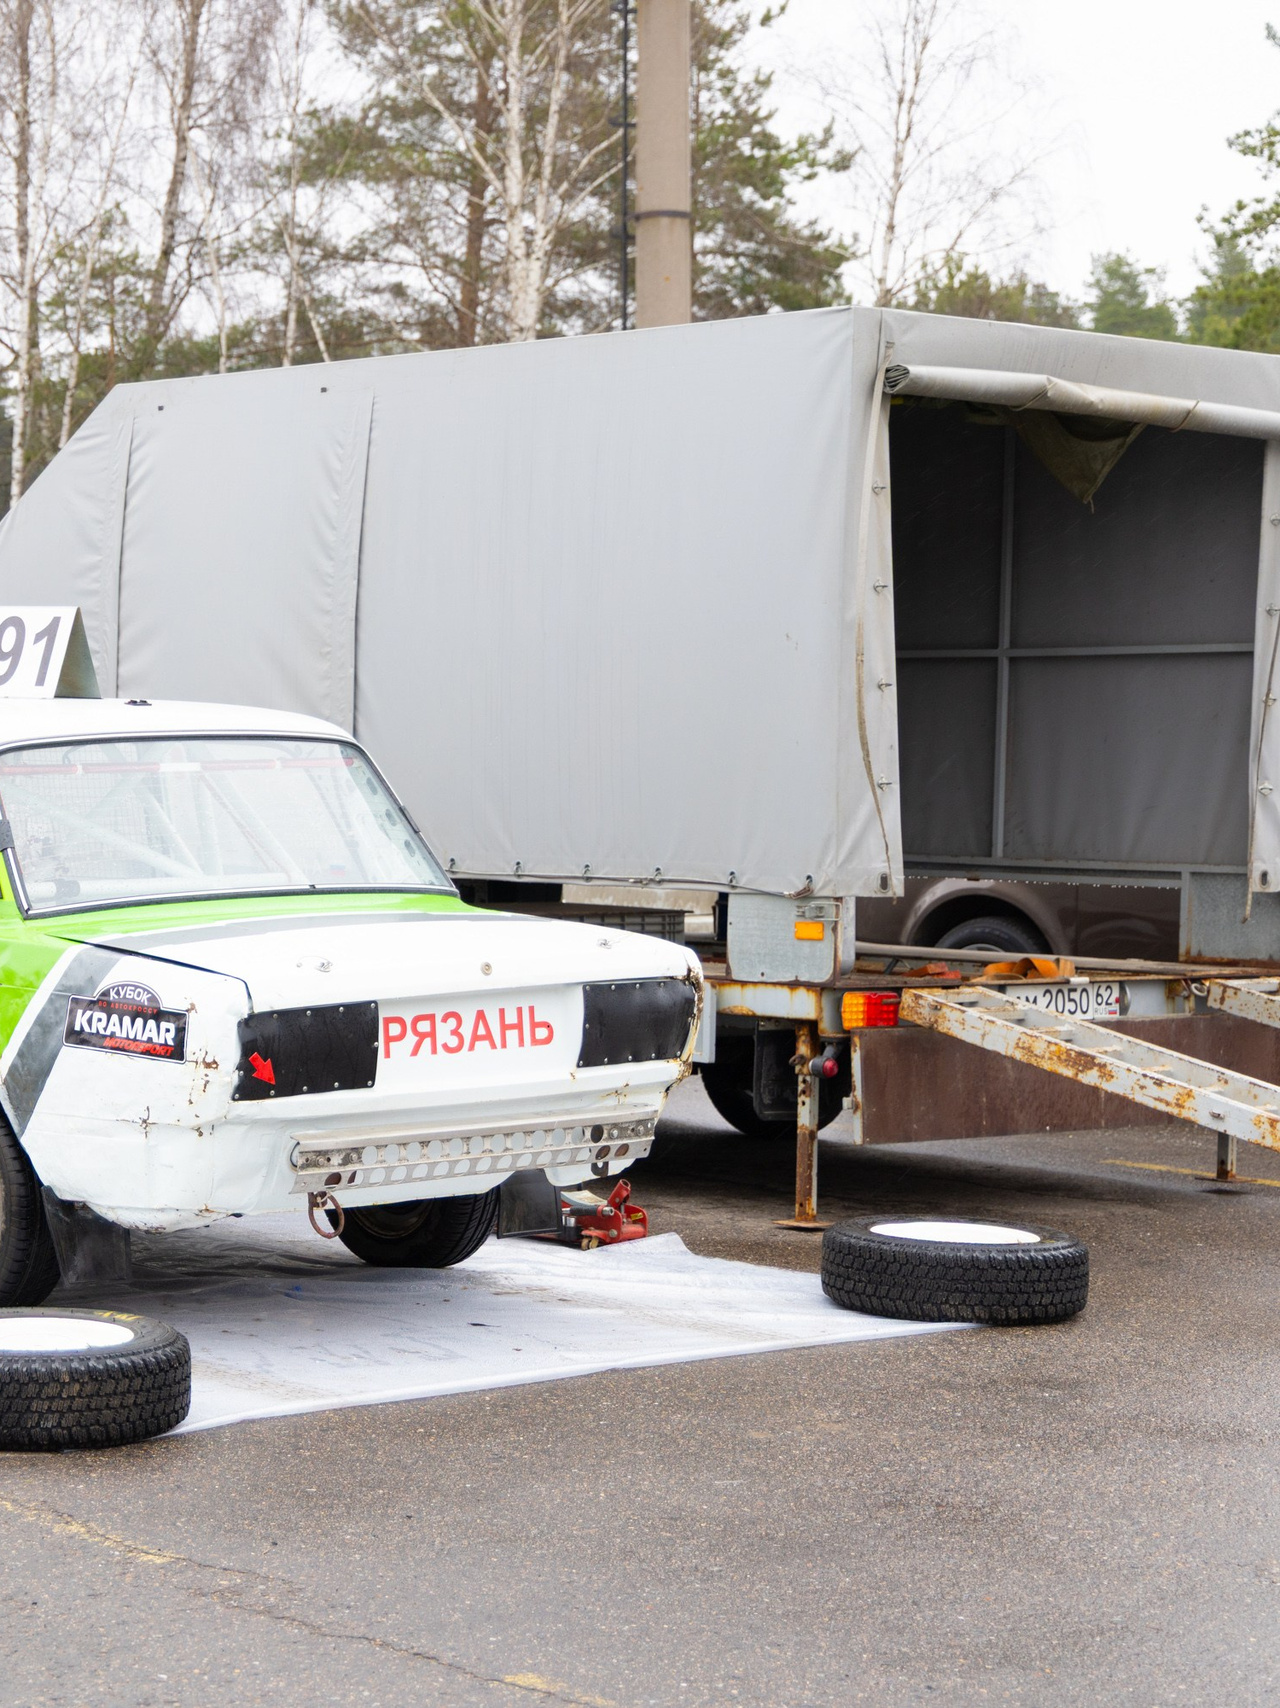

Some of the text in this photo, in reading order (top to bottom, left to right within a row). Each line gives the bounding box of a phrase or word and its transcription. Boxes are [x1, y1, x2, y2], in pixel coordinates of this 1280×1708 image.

[109, 985, 152, 1006] КУБОК
[1042, 986, 1090, 1016] 2050
[1095, 984, 1113, 1006] 62
[110, 1002, 158, 1015] АВТОКРОССУ
[1094, 1007, 1108, 1016] RUS
[74, 1009, 176, 1046] KRAMAR
[382, 1005, 554, 1059] РЯЗАНЬ
[102, 1037, 175, 1057] MOTORSPORT
